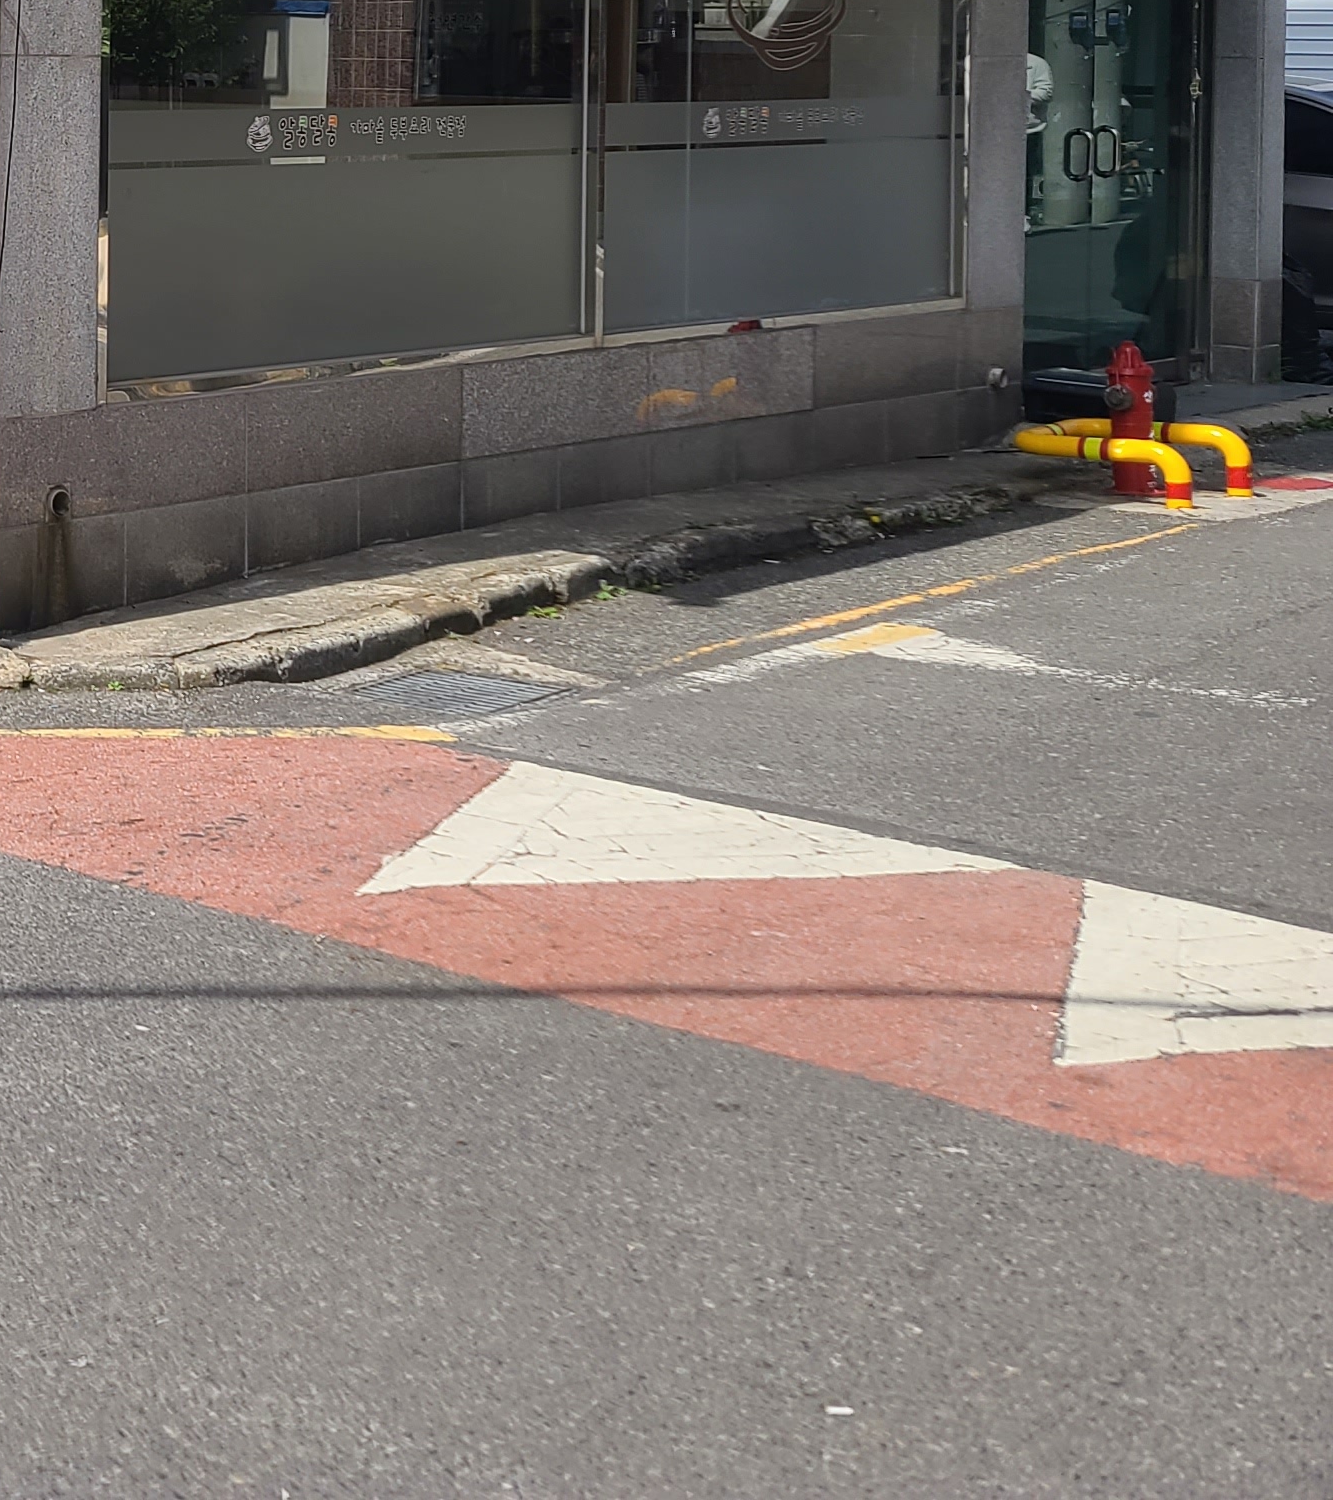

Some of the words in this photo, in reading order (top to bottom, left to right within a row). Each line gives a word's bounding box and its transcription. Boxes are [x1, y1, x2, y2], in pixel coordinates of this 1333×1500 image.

[278, 114, 339, 150] 알콩달콩
[389, 115, 432, 141] 두부요리
[436, 114, 467, 139] 전문점
